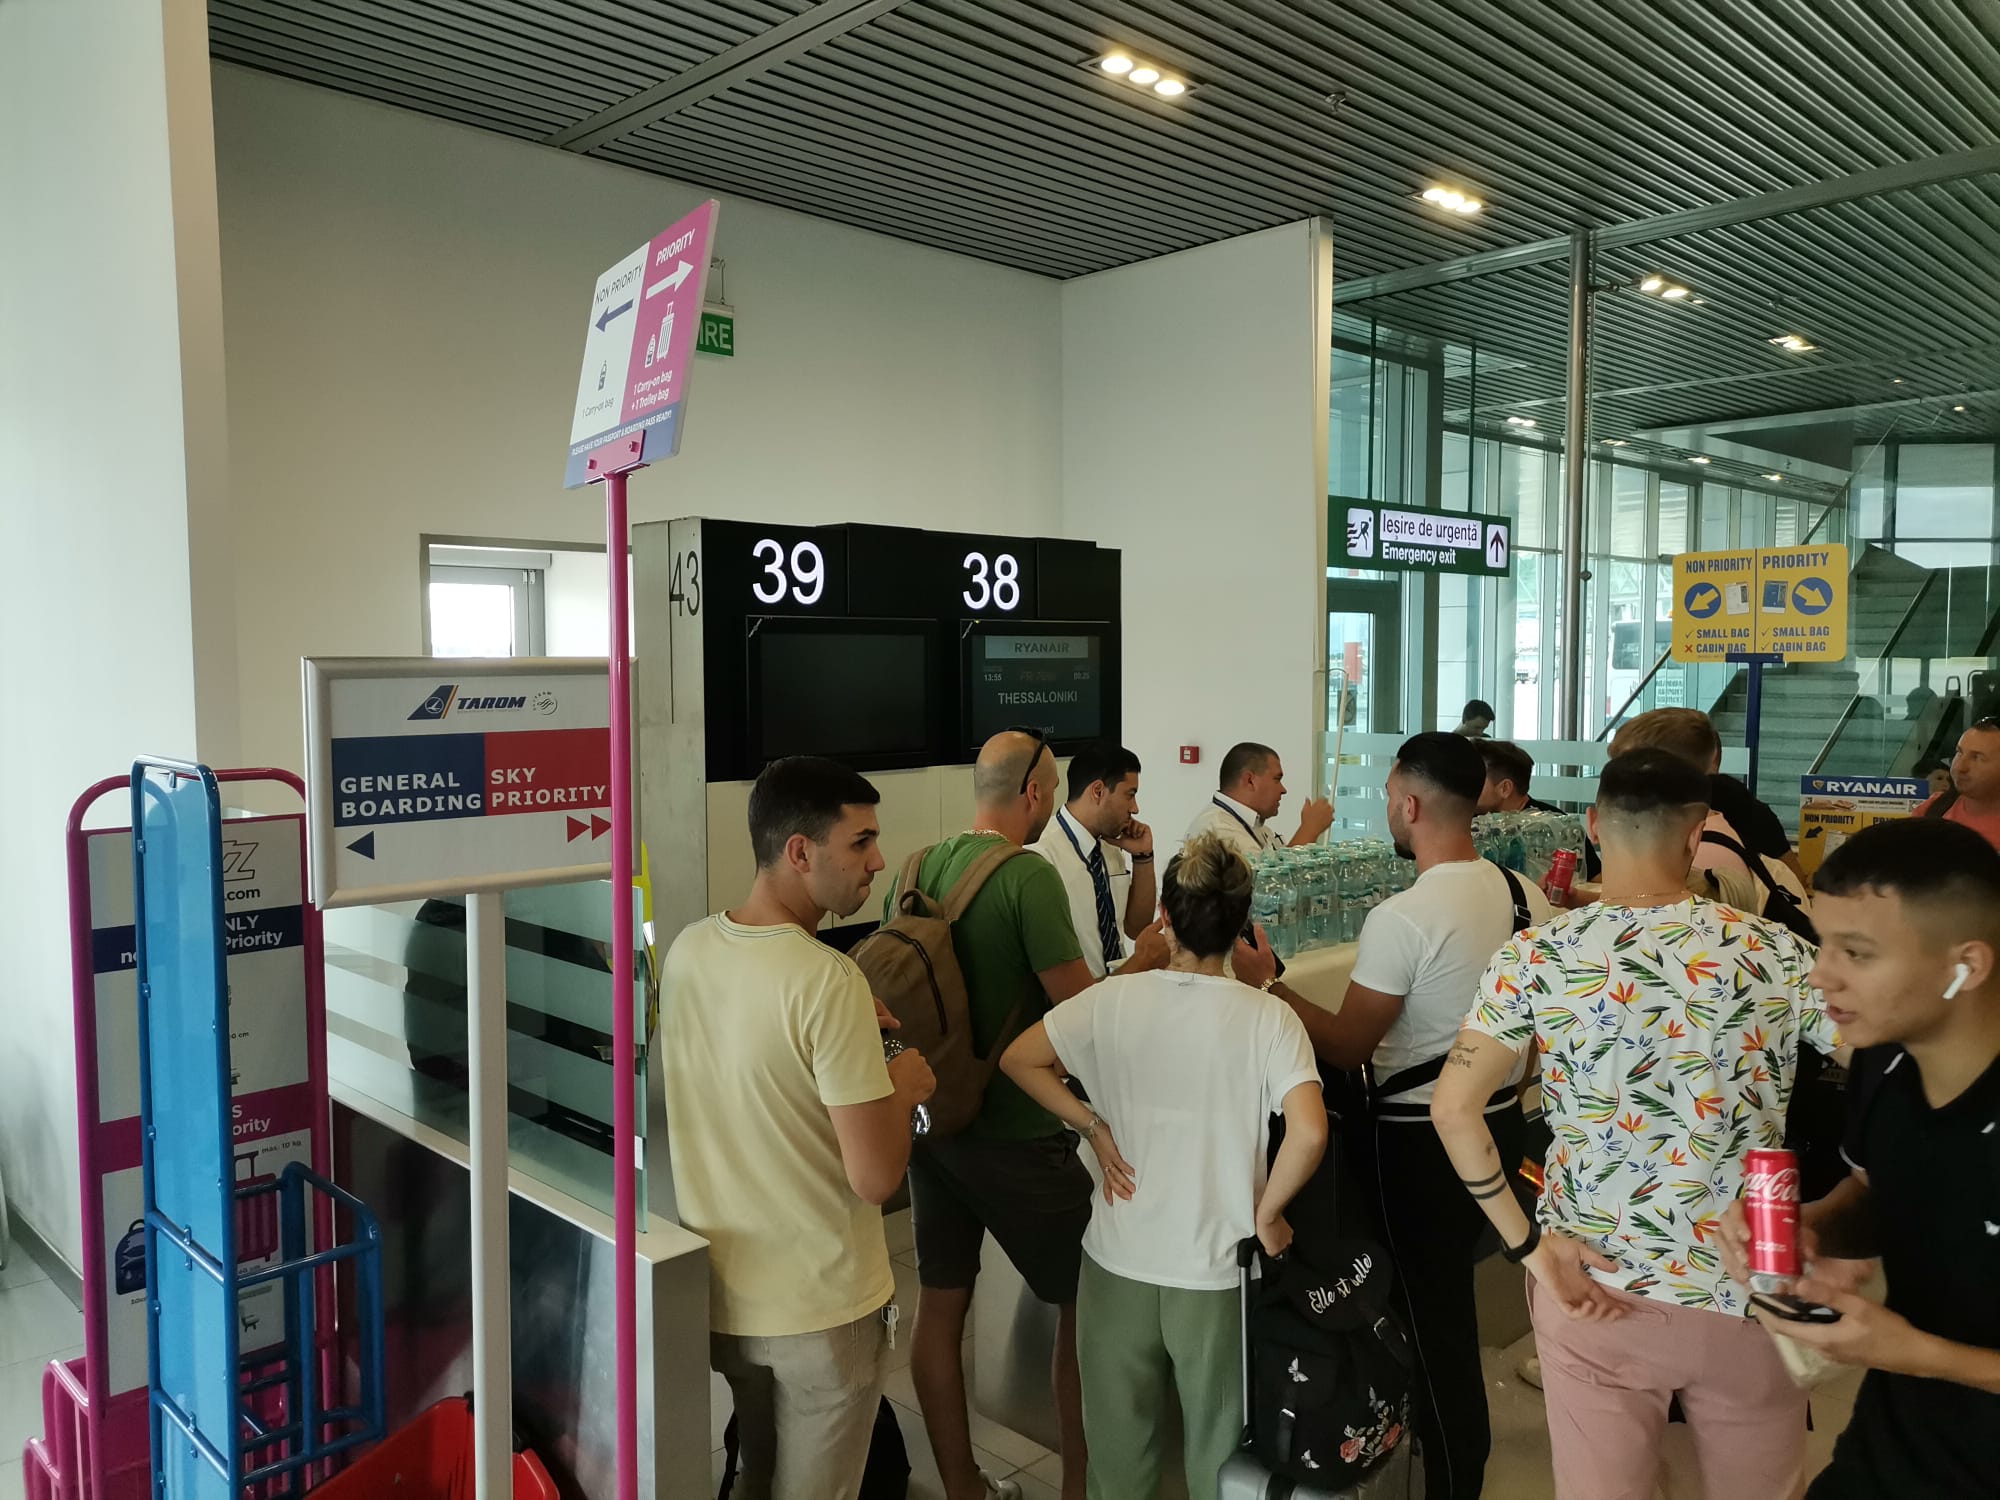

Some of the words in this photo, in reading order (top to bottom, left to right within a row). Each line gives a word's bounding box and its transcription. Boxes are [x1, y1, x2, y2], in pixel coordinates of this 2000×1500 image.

[655, 228, 696, 266] PRIORITY
[595, 286, 611, 304] NON
[611, 263, 644, 295] PRIORITY
[1419, 518, 1433, 537] de
[1382, 543, 1438, 566] Emergency
[1439, 549, 1457, 564] exit
[1762, 552, 1829, 569] PRIORITY
[752, 538, 825, 605] 39
[1686, 560, 1705, 573] NON
[1708, 557, 1752, 573] PRIORITY
[670, 551, 700, 617] 43
[962, 551, 1021, 611] 38
[1696, 628, 1728, 639] SMALL
[1731, 627, 1750, 638] BAG
[1772, 627, 1806, 638] SMALL
[1809, 626, 1830, 636] BAG
[1014, 642, 1069, 653] RYANAIR
[1696, 643, 1726, 654] CABIN
[1728, 643, 1746, 653] BAG
[1772, 642, 1803, 653] CABIN
[1806, 641, 1826, 652] BAG
[457, 696, 527, 710] TAROM
[998, 690, 1078, 705] THESSALONIKI
[340, 771, 461, 794] GENERAL
[491, 767, 537, 785] SKY
[491, 785, 607, 808] PRIORITY
[1826, 780, 1917, 796] RYANAIR
[341, 793, 482, 818] BOARDING
[225, 914, 259, 932] NLY
[232, 1117, 271, 1136] ority
[1305, 1287, 1335, 1315] Elle
